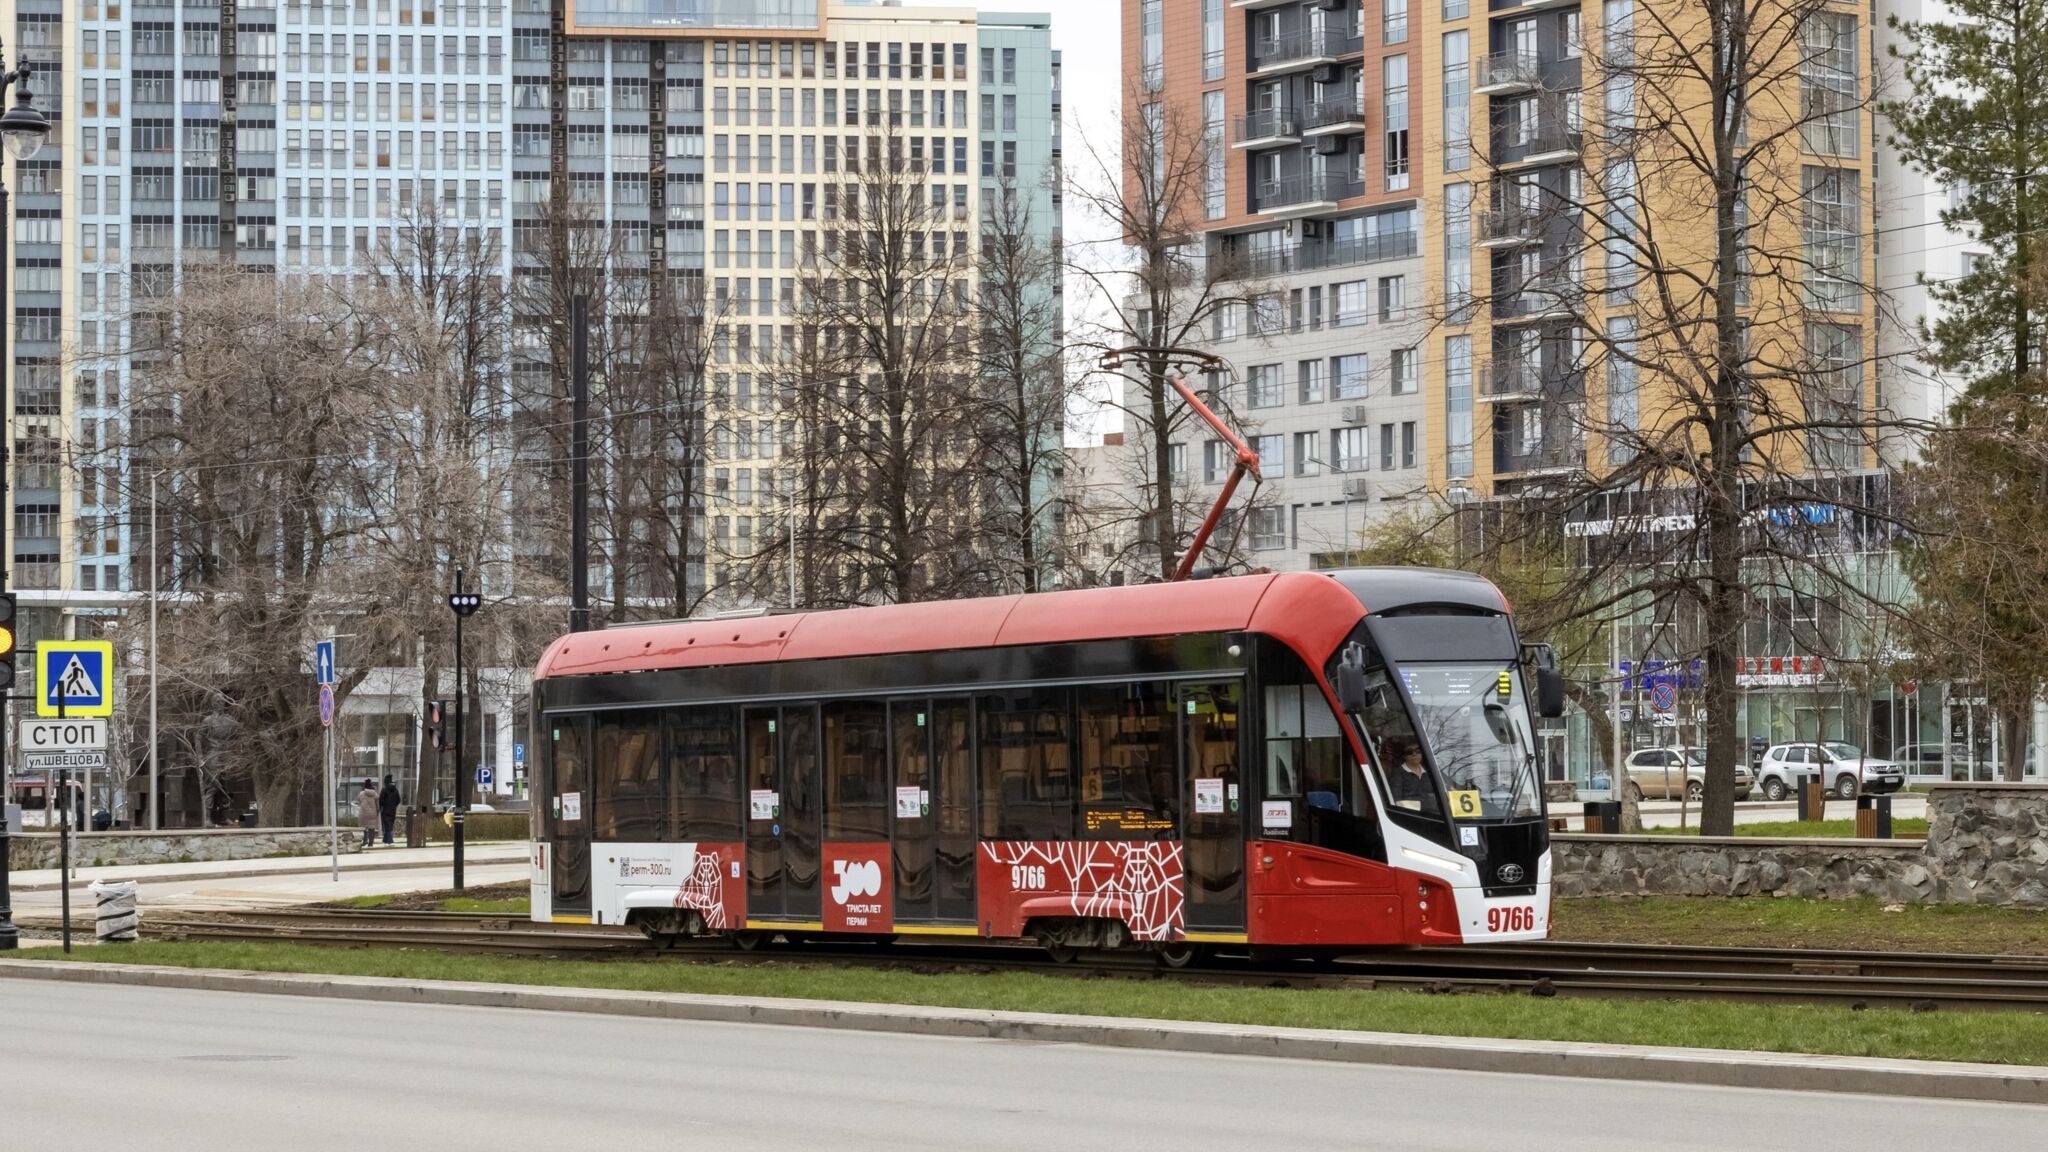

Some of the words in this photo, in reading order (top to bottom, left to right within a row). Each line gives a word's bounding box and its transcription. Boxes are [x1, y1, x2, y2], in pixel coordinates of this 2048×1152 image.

[33, 725, 95, 745] СТОП
[29, 754, 102, 768] ул.ШВЕЦОВА
[1459, 793, 1474, 813] 6
[630, 863, 672, 877] perm-300.ru
[1012, 865, 1046, 889] 9766
[831, 860, 882, 905] 300
[846, 904, 870, 913] ТРИСТА
[870, 904, 882, 914] ЛЕТ
[846, 917, 868, 926] ПЕРМИ
[1487, 906, 1534, 933] 9766
